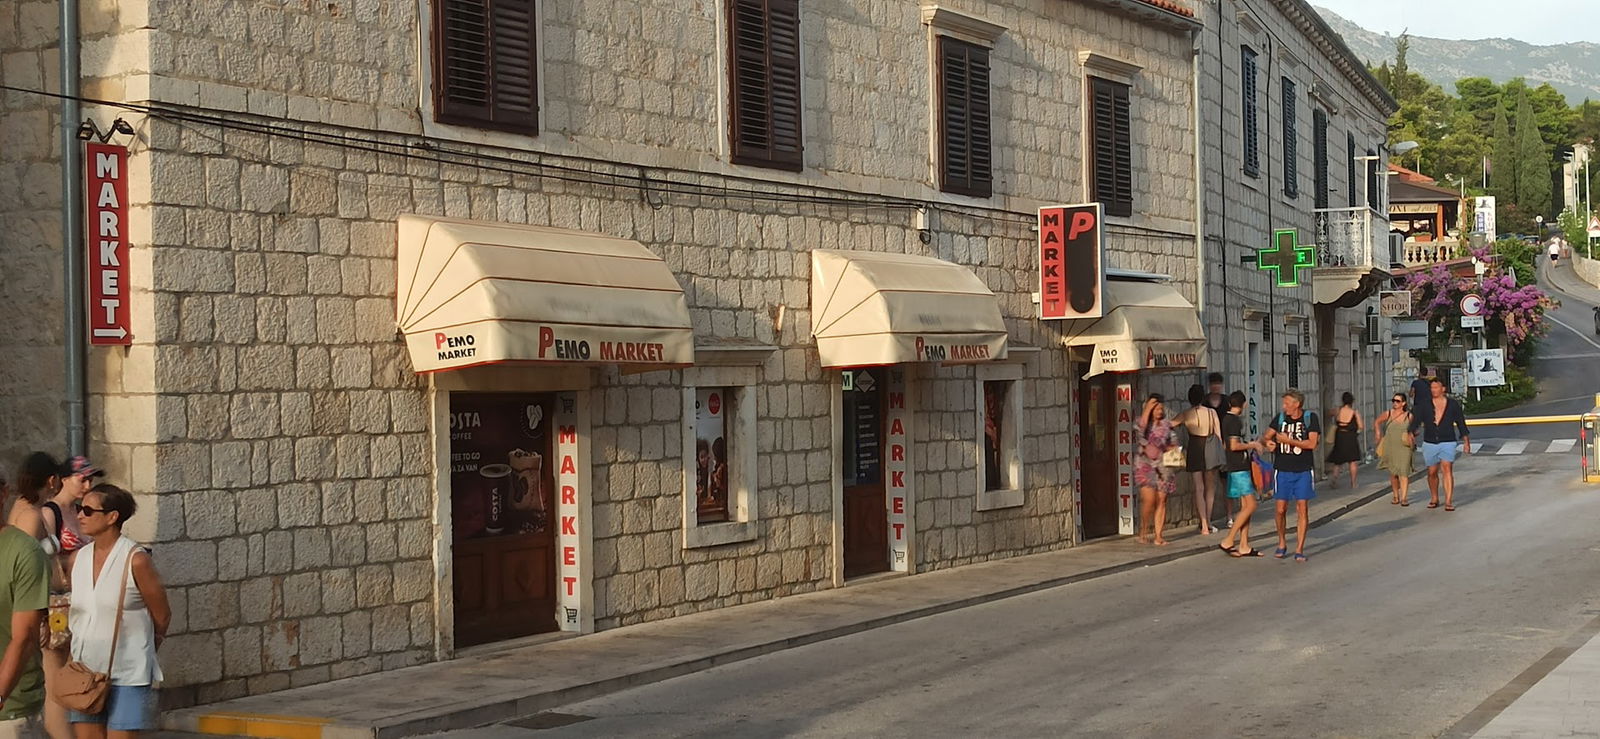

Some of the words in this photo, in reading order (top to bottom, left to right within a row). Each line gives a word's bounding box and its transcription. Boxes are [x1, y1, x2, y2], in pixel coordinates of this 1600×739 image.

[96, 152, 120, 325] MARKET
[1069, 211, 1095, 241] P
[1043, 214, 1059, 312] MARKET
[1382, 303, 1408, 311] SHOP
[435, 332, 475, 350] PEMO
[437, 347, 476, 361] MARKET
[538, 326, 591, 360] PEMO
[599, 341, 664, 362] MARKET
[915, 336, 946, 361] PEMO
[950, 344, 991, 360] MARKET
[1169, 353, 1196, 366] MARKET
[463, 452, 471, 460] TO
[471, 451, 481, 460] GO
[1072, 389, 1081, 516] MARKET
[1117, 388, 1130, 509] MARKET
[465, 463, 478, 472] VAN
[889, 391, 905, 540] MARKET
[559, 425, 577, 597] MARKET
